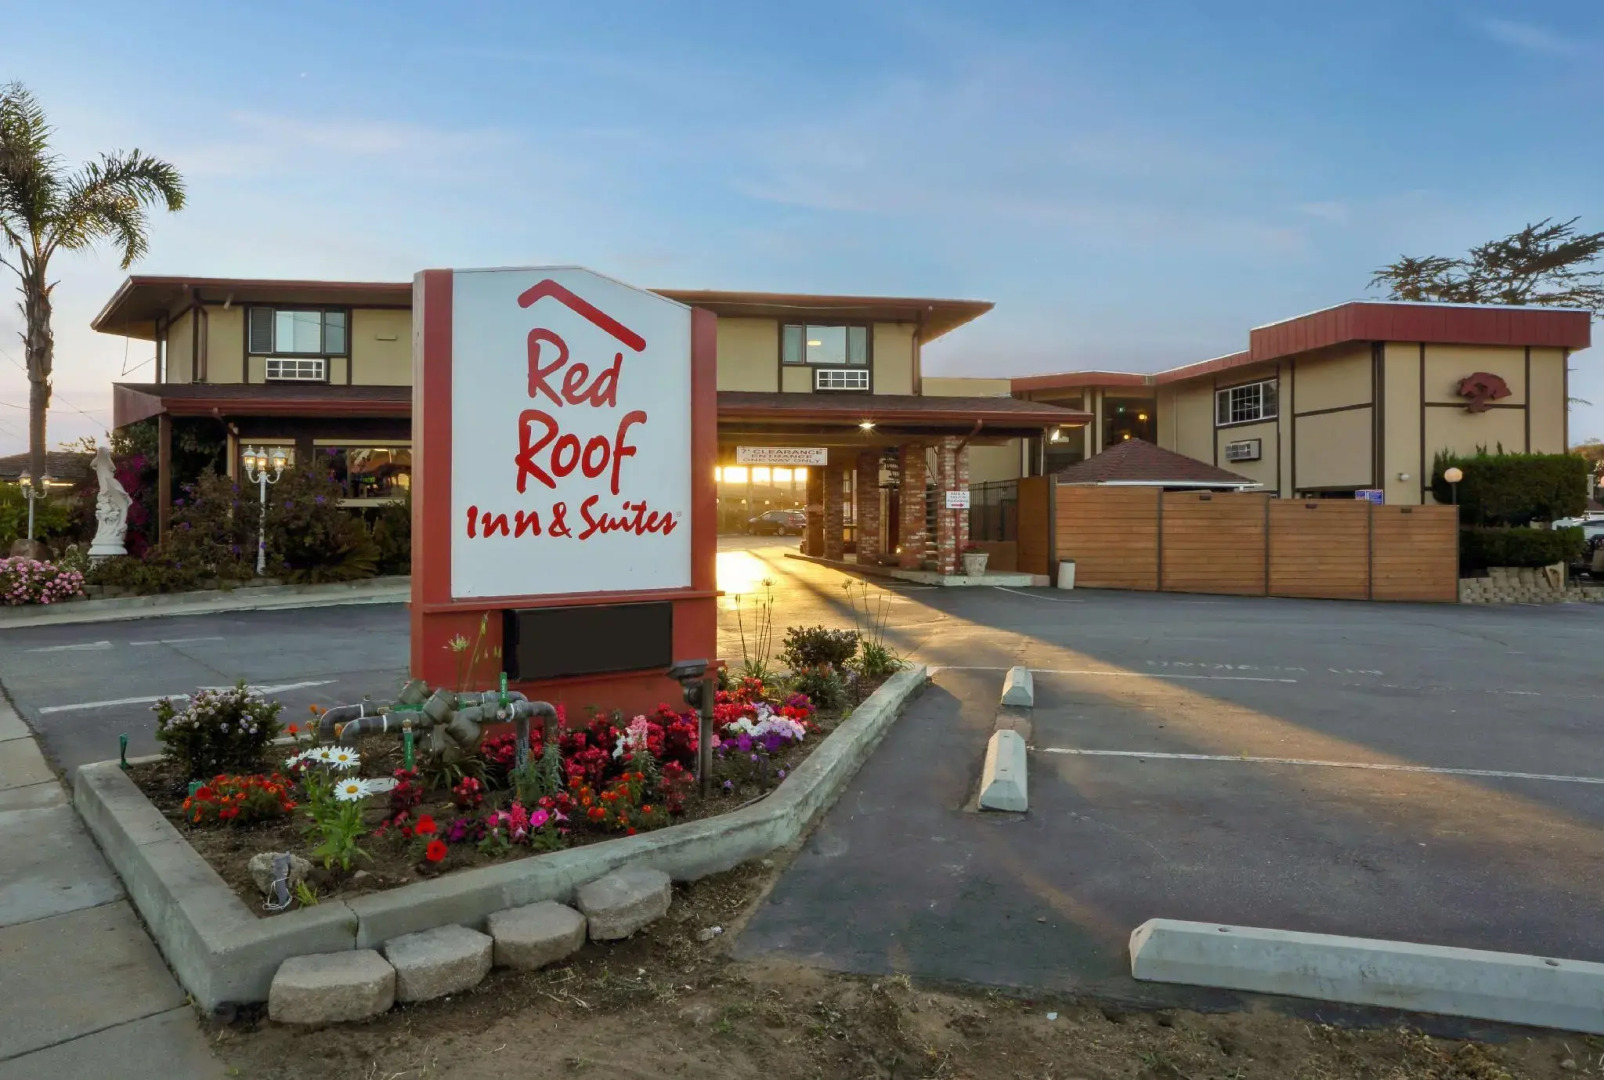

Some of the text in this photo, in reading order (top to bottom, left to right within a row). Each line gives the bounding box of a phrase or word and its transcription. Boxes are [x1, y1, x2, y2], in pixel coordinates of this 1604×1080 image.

[527, 328, 623, 407] Red
[515, 409, 647, 495] Roof
[467, 494, 678, 540] Inn & Suites
